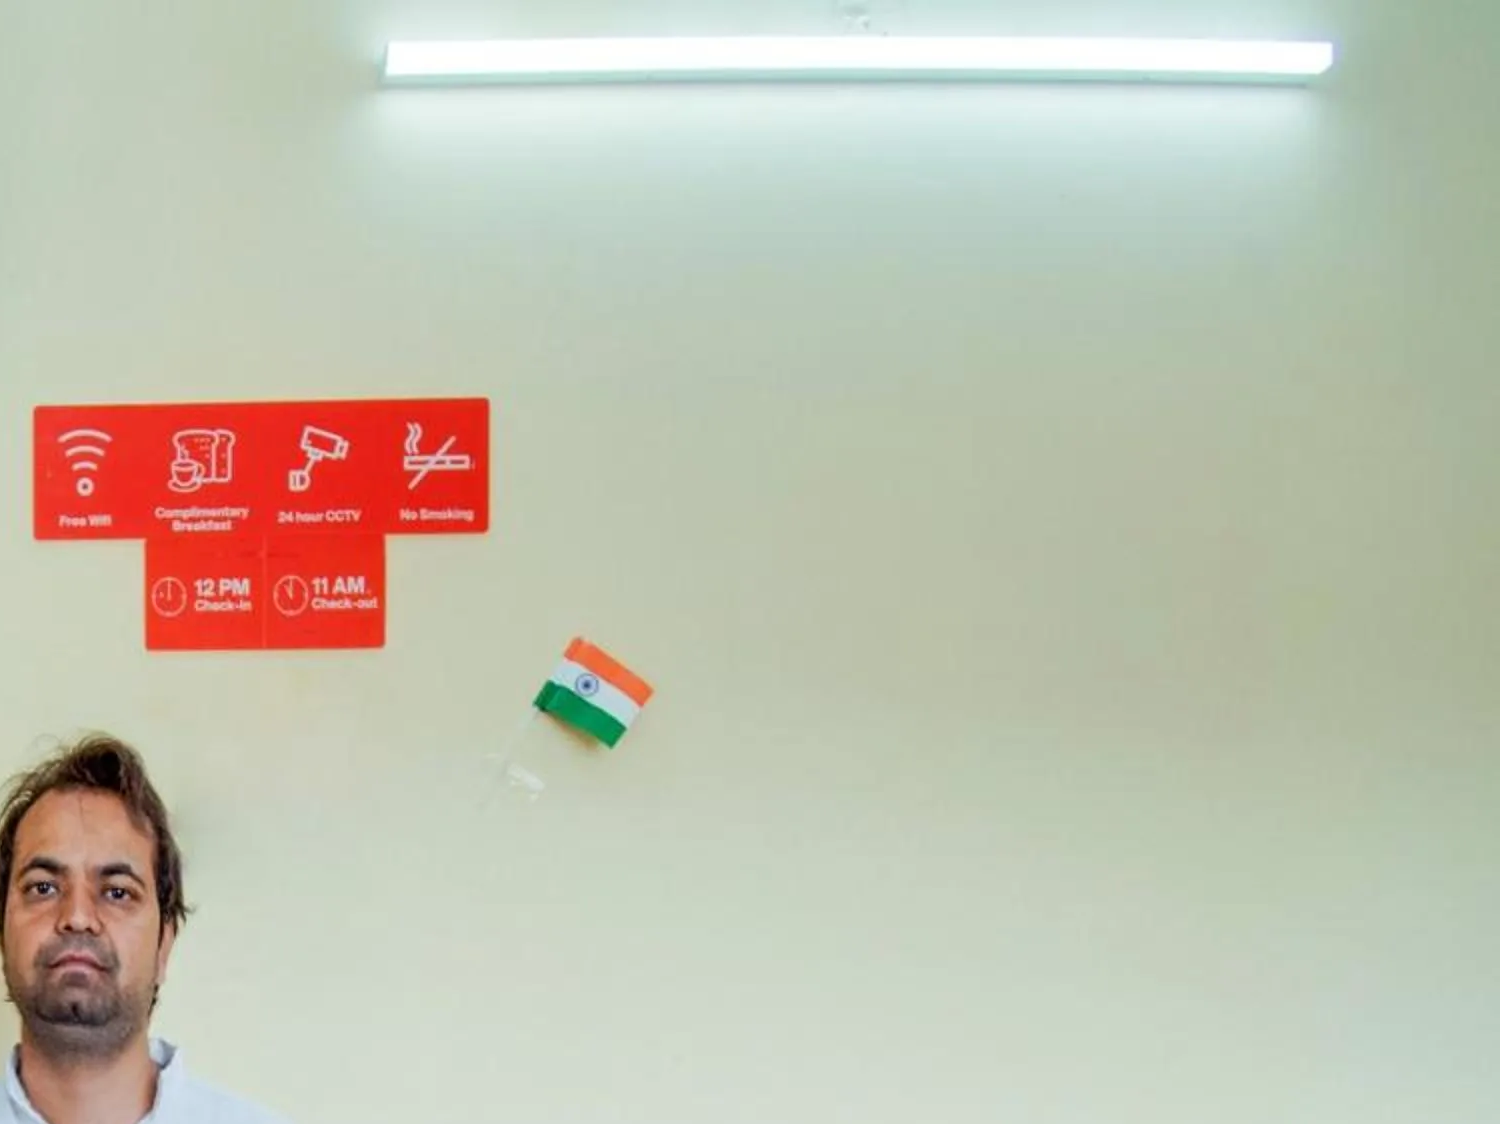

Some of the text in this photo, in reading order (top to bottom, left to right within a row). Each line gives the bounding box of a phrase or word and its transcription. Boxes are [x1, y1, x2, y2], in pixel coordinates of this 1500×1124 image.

[154, 507, 250, 519] Complimentary
[277, 509, 362, 523] 24 hour CCTV
[399, 508, 475, 521] No Smoking
[59, 515, 86, 527] Free
[171, 520, 232, 531] Breakfast
[194, 577, 250, 597] 12 PM
[311, 575, 365, 594] 11 AM
[194, 599, 252, 611] Check-in
[311, 597, 378, 609] Check-out
